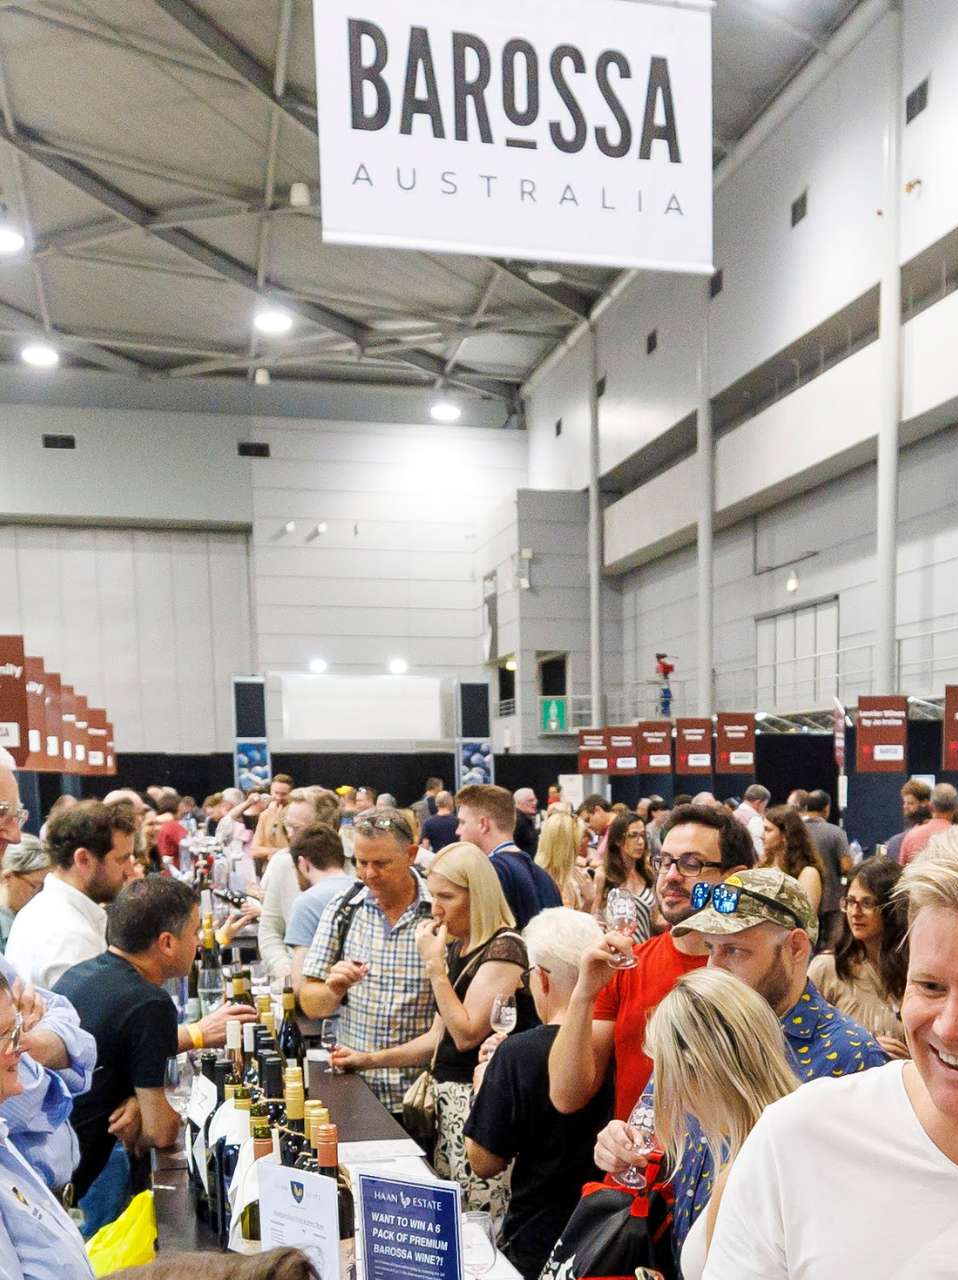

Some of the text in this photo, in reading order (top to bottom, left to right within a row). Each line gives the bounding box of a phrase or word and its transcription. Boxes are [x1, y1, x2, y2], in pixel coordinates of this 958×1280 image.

[347, 17, 683, 164] BAROSSA
[352, 163, 685, 216] AUSTRALIA
[374, 1191, 442, 1211] HAAN ESTATE
[371, 1212, 441, 1234] WANT TO WIN A 6
[372, 1228, 449, 1251] PACK OF PREMIUM
[373, 1244, 444, 1267] BAROSSA WINE?!
